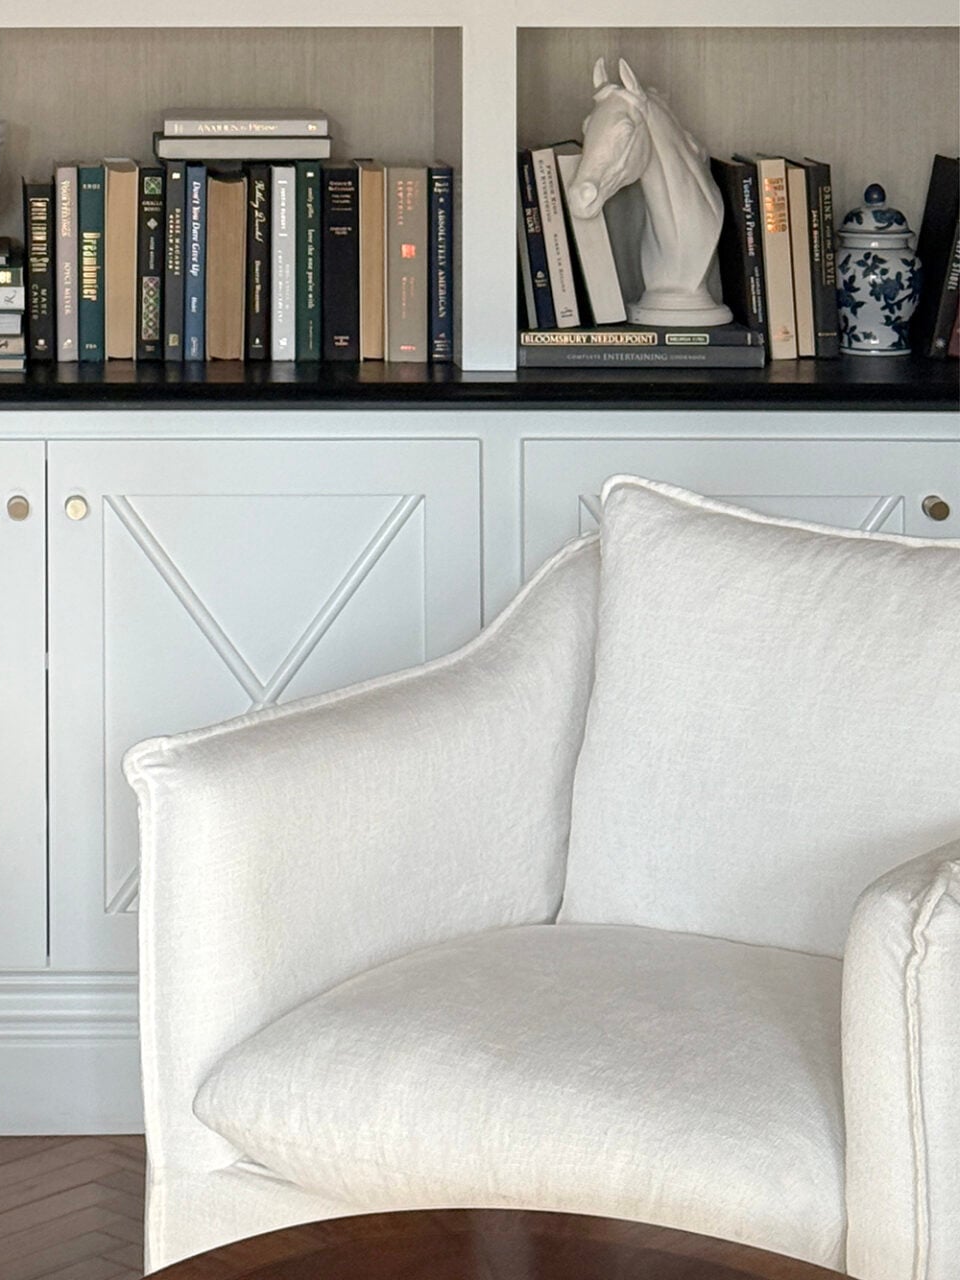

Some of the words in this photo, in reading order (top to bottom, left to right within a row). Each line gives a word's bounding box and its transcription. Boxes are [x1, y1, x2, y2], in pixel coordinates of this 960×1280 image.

[190, 181, 201, 204] Don't
[742, 177, 755, 219] Tuesday's
[823, 186, 832, 221] DRINK
[190, 206, 201, 220] You
[190, 222, 201, 241] Dare
[437, 208, 447, 265] ABSOLUTELY
[746, 220, 756, 256] Promise
[82, 232, 101, 301] Dreamhunter
[190, 243, 201, 261] Give
[189, 263, 200, 277] Up
[825, 253, 836, 285] DEVIL
[437, 269, 447, 318] AMERICAN
[524, 334, 588, 344] BLOOMSBURY
[590, 334, 654, 344] NEEDLEPOINT
